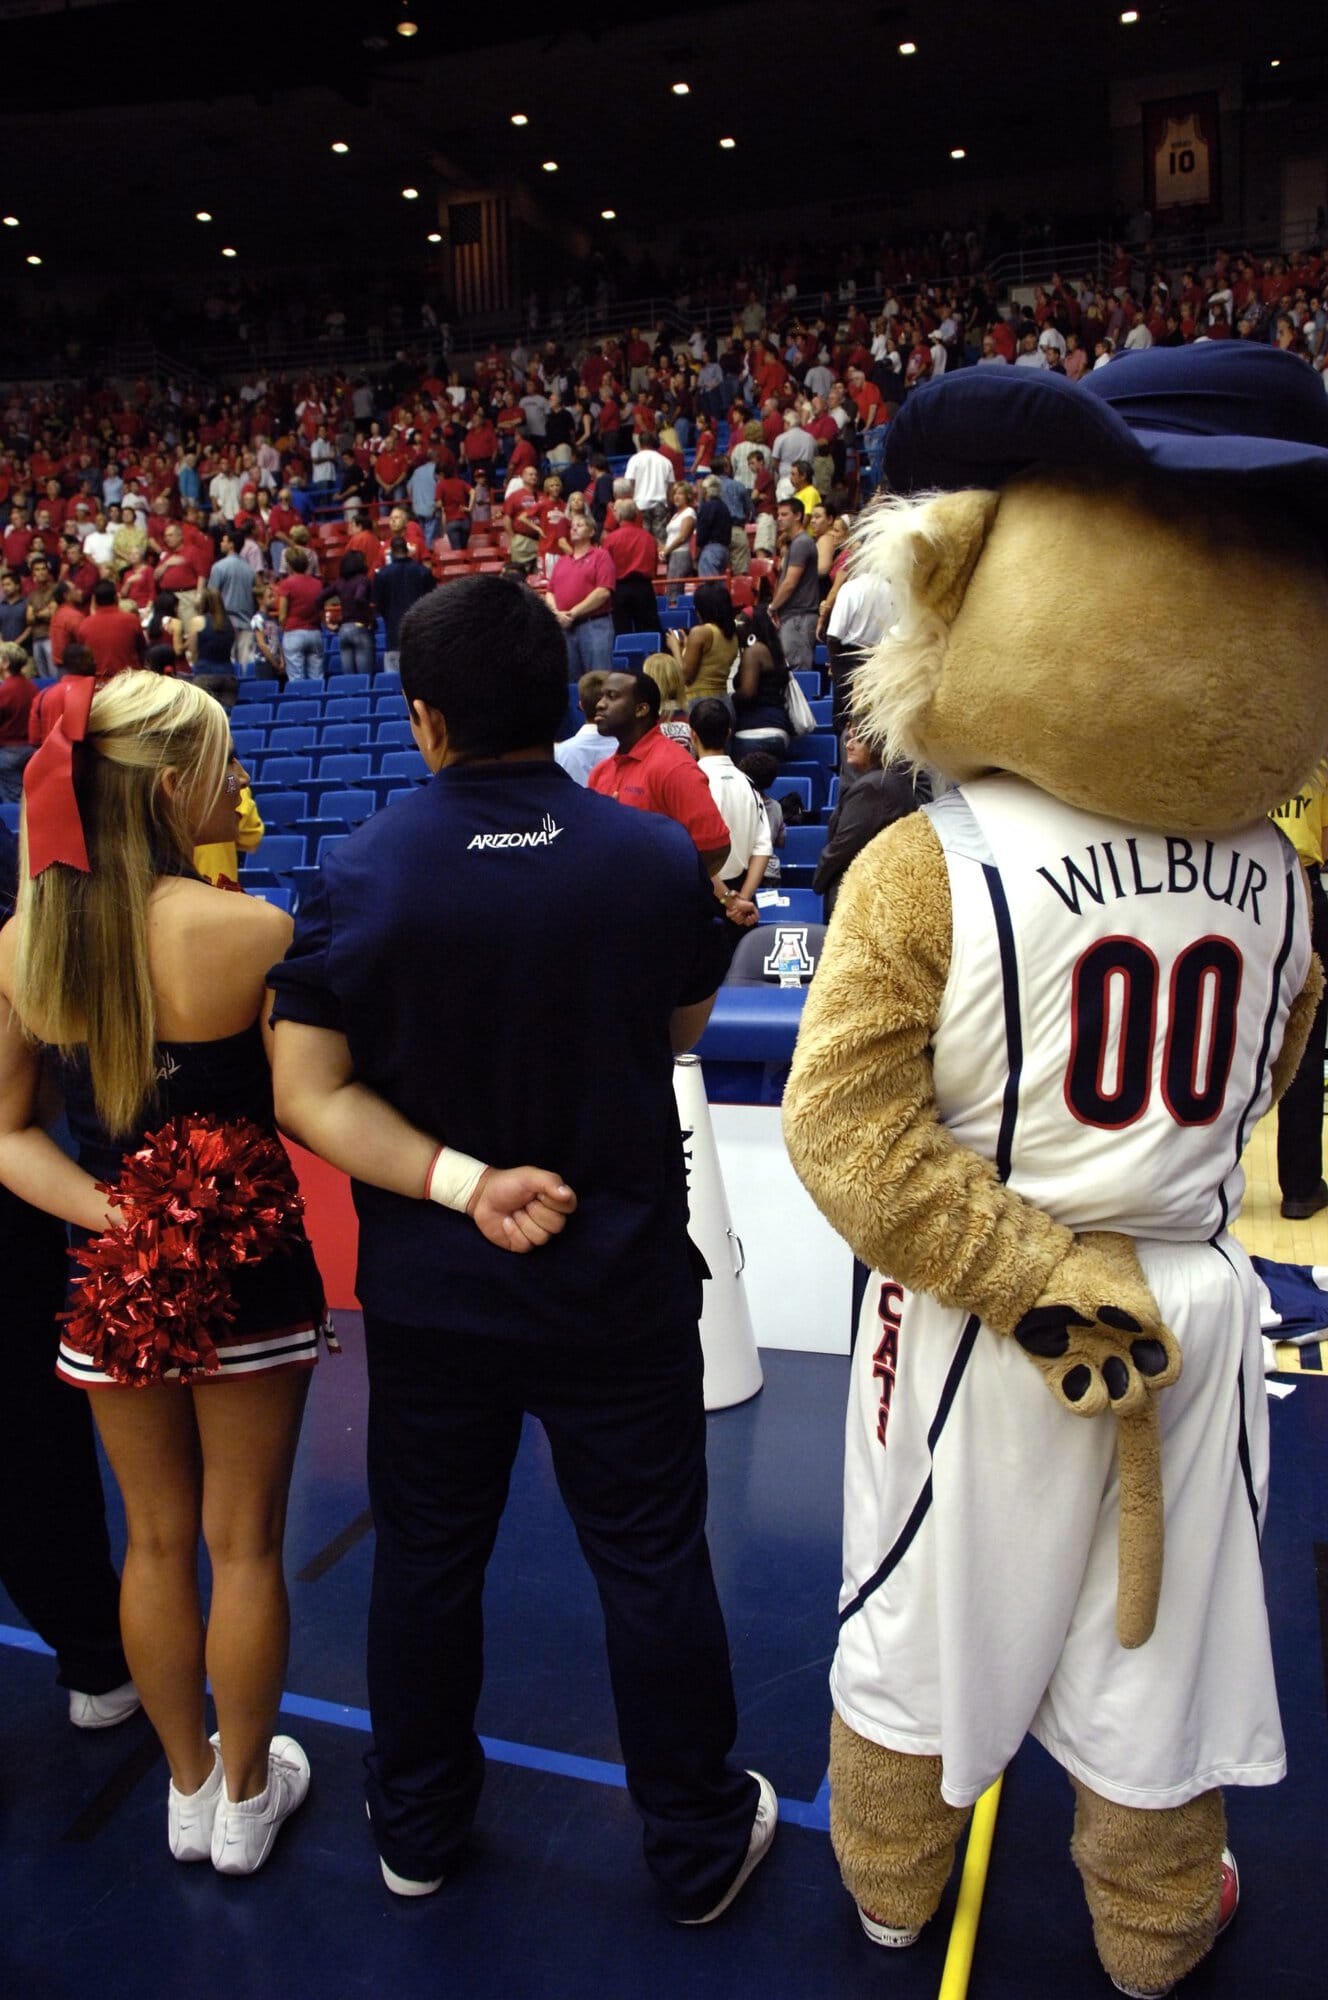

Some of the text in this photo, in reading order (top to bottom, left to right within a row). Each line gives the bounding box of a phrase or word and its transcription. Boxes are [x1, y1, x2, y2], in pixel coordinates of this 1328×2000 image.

[1169, 149, 1195, 175] 10
[467, 831, 552, 850] ARIZONA
[1036, 836, 1267, 926] WILBUR
[764, 928, 814, 975] A
[1064, 934, 1243, 1131] 00
